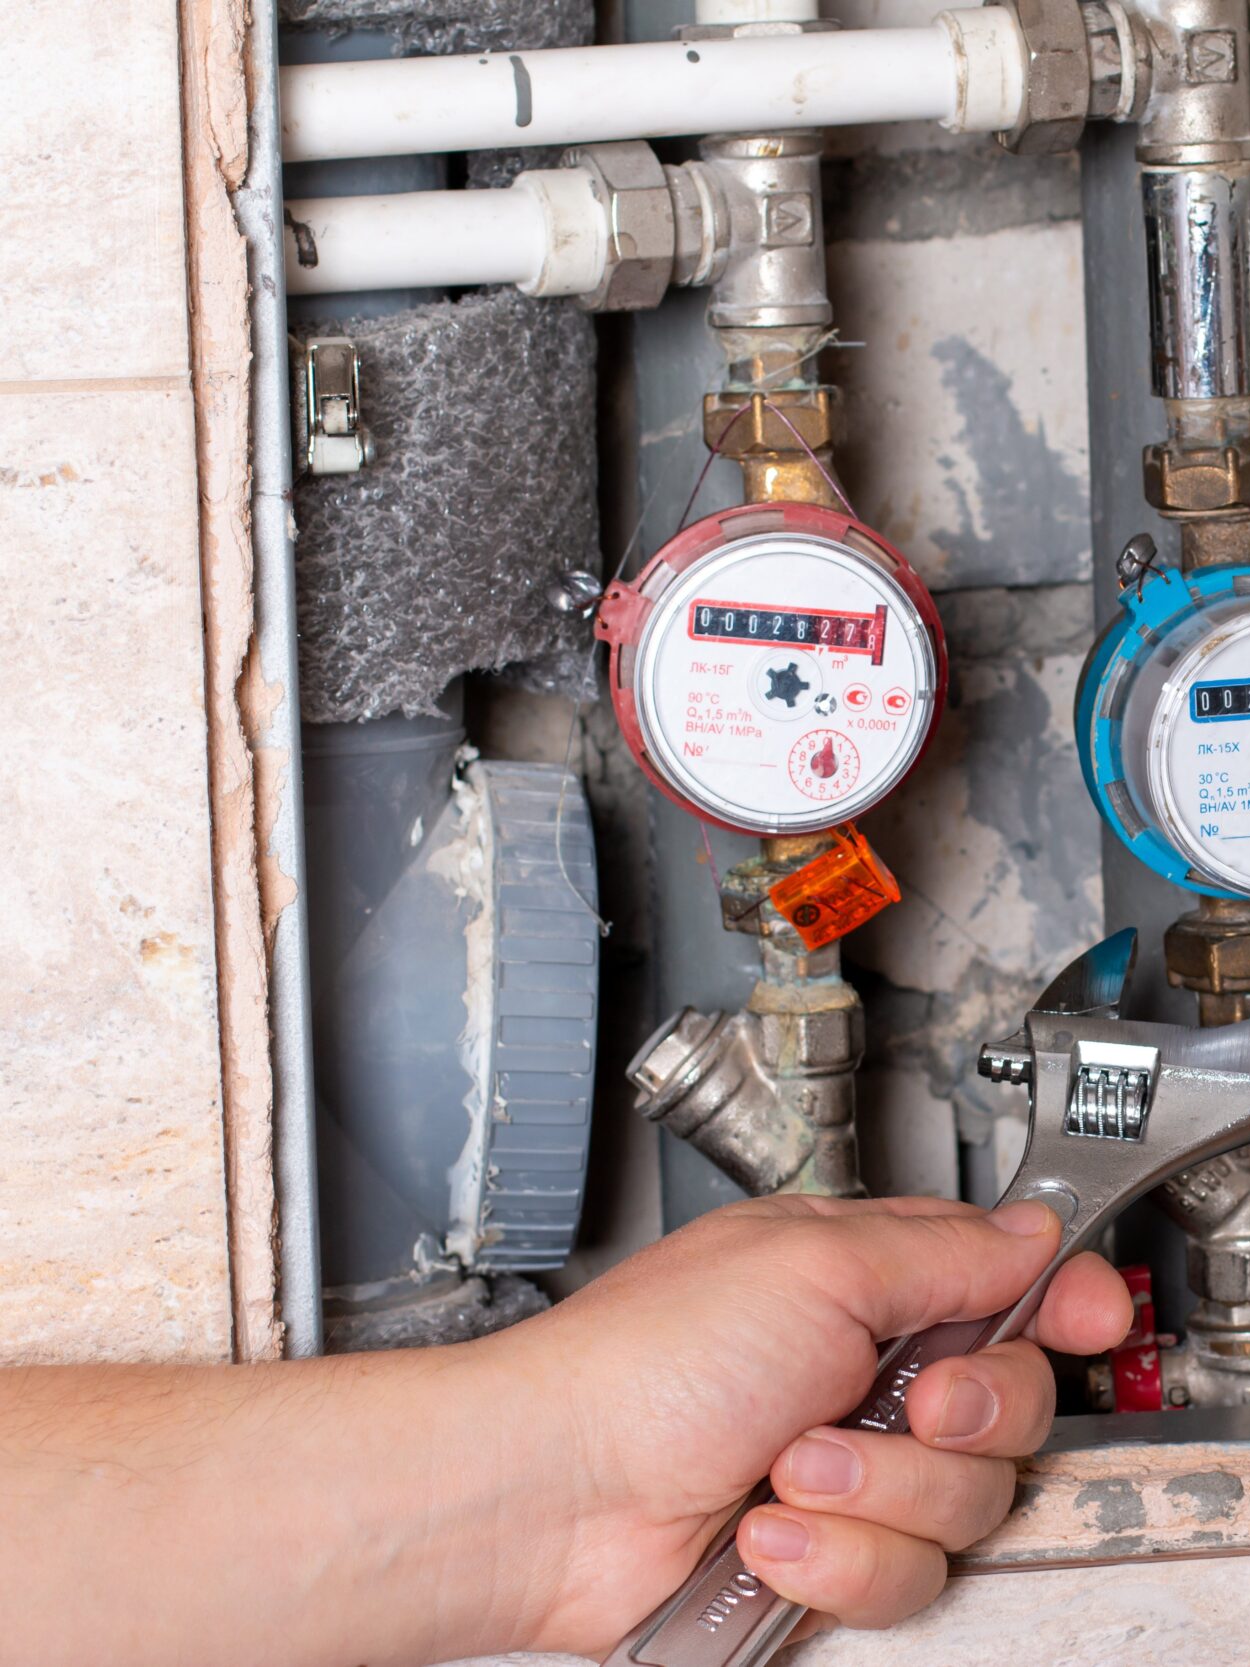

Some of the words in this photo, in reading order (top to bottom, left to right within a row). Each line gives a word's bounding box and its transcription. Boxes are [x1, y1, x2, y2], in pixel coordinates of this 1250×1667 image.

[688, 692, 703, 703] 90
[728, 725, 762, 738] 1MPa
[1198, 773, 1213, 785] 30
